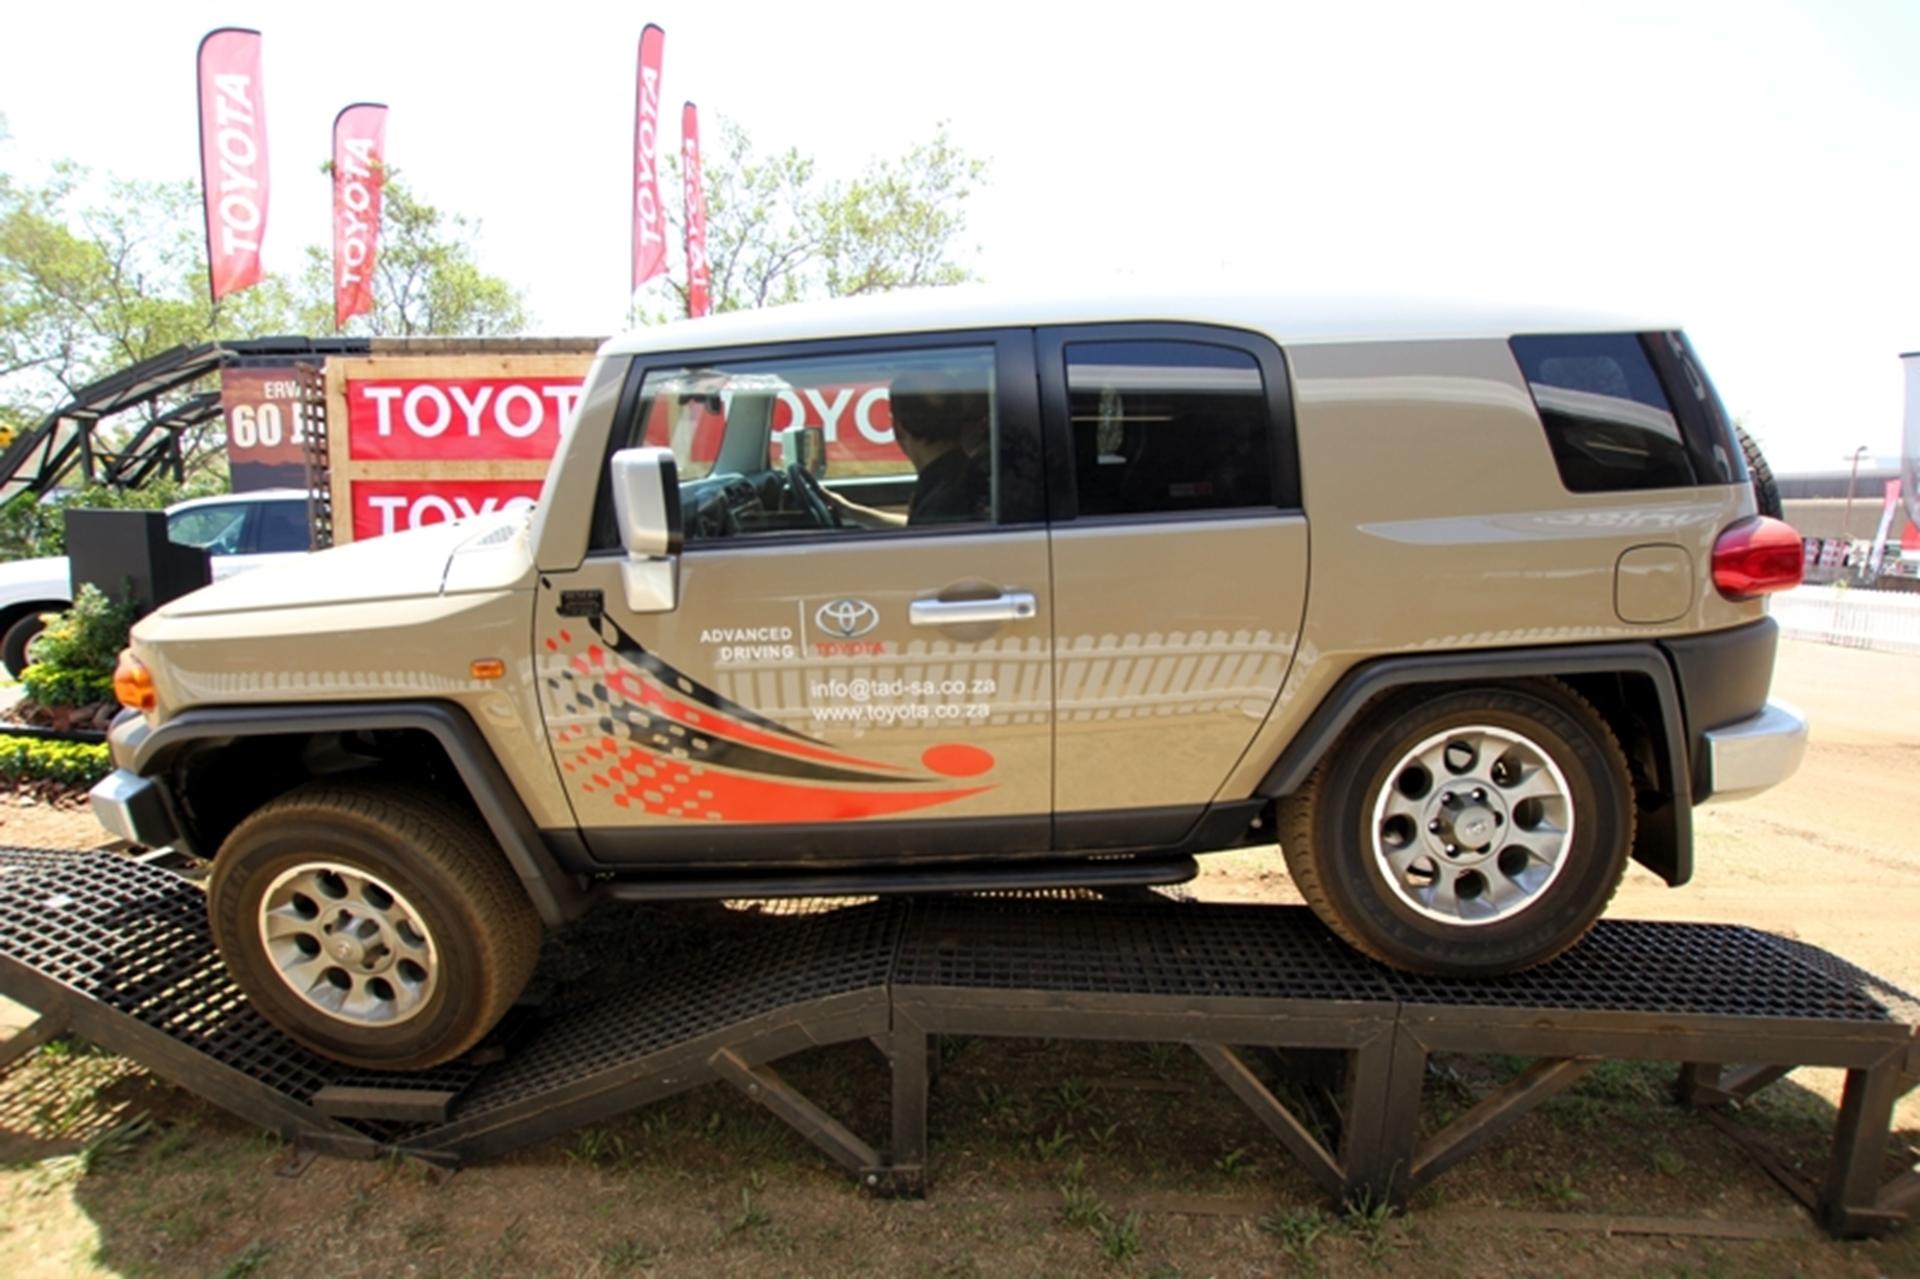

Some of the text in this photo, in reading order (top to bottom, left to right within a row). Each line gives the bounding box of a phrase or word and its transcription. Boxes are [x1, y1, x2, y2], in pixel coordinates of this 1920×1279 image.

[214, 73, 260, 257] TOYOTA
[637, 66, 661, 246] TOYOTA
[340, 137, 375, 289] TOYOTA
[232, 403, 283, 448] 60
[700, 626, 793, 643] ADVANCED
[720, 644, 794, 660] DRIVING
[815, 641, 886, 657] TOYOTA
[811, 678, 996, 701] info@tad-sa.co.za
[812, 703, 991, 724] www.toyota.co.za
